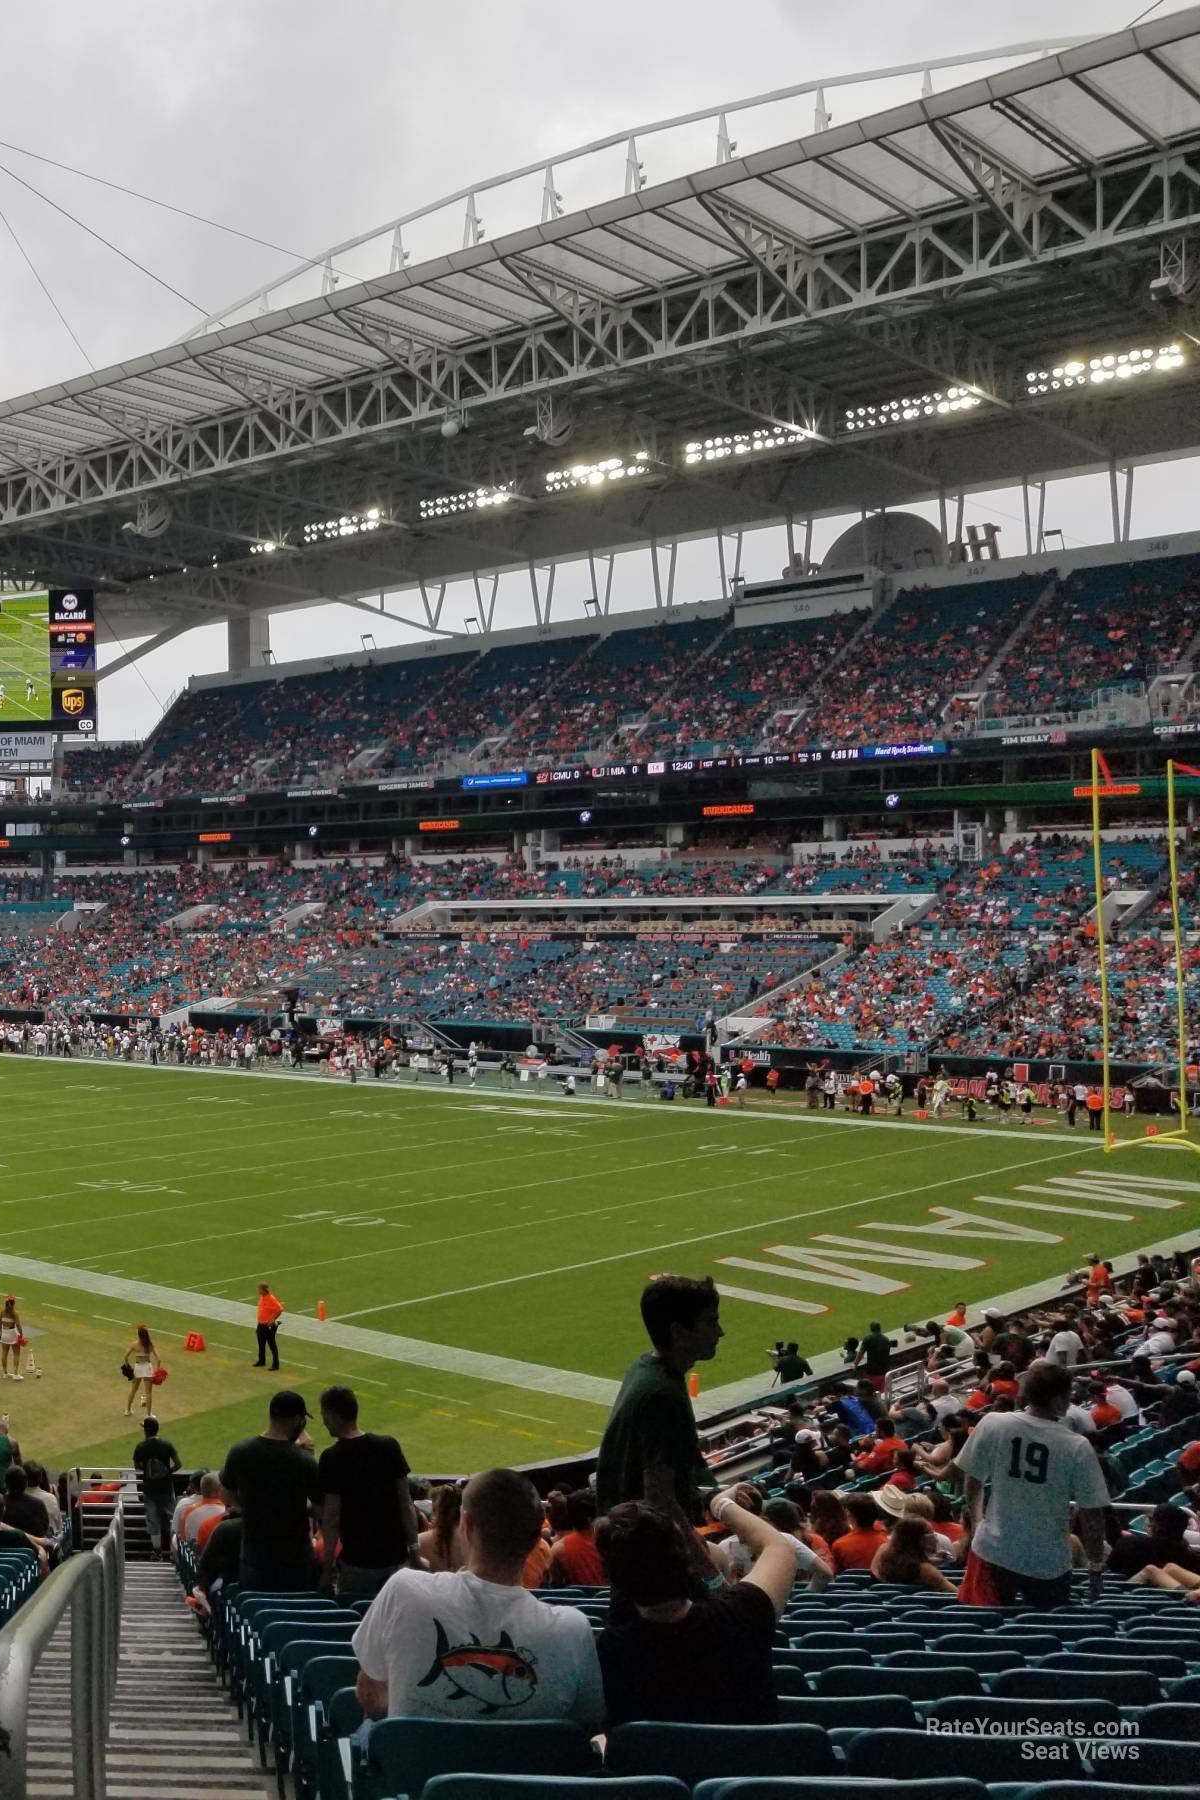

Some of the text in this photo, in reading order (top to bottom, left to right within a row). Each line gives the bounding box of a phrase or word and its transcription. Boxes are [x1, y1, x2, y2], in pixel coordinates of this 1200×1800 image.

[967, 567, 985, 577] 347
[54, 610, 86, 620] BACARDÍ
[63, 696, 83, 711] ups
[1153, 724, 1194, 735] CORTEZ
[0, 737, 13, 746] OF
[14, 736, 45, 746] MIAMI
[1001, 737, 1018, 745] JIM
[1020, 734, 1049, 744] KELLY
[848, 750, 859, 759] PM
[875, 744, 933, 756] Hard Rock Stadium
[764, 756, 774, 765] 10
[811, 752, 821, 761] 15
[610, 766, 638, 776] MIA 0
[671, 761, 693, 771] 12:40
[552, 770, 580, 781] CMU 0
[406, 781, 428, 790] JAMES
[703, 804, 754, 815] HURRICANES
[1008, 1436, 1049, 1484] 19
